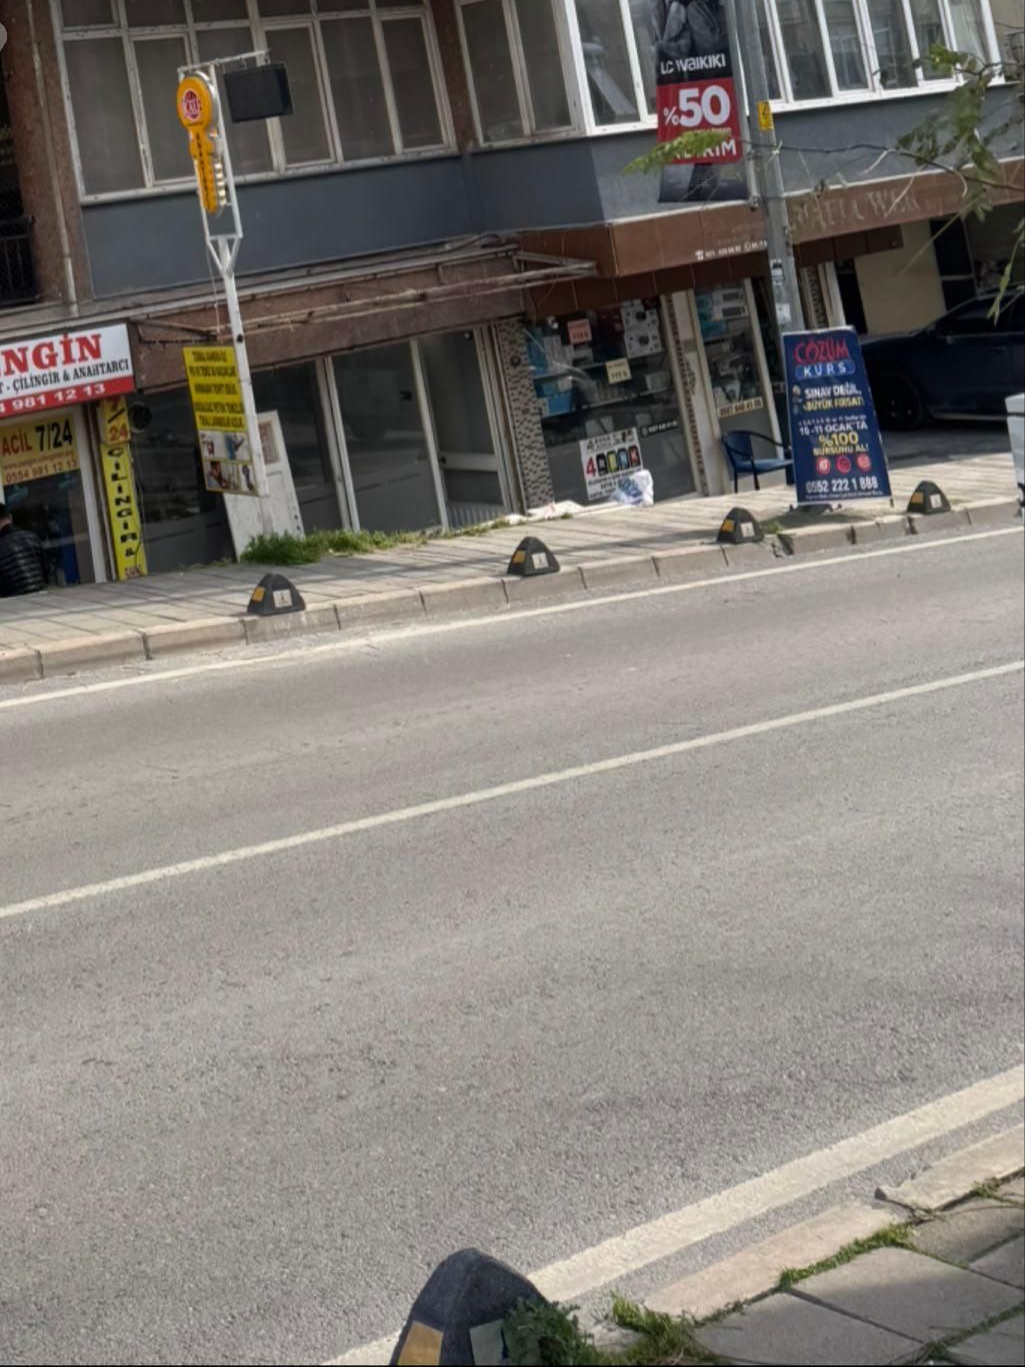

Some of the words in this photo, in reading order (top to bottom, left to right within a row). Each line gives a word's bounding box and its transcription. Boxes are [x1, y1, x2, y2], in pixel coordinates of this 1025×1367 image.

[660, 60, 675, 74] LC
[663, 85, 731, 127] %50
[13, 372, 61, 393] ÇİLİNGİR
[73, 358, 130, 380] ANAHTARCI
[803, 365, 847, 378] KURS
[11, 395, 47, 410] 981
[53, 390, 77, 402] 12
[82, 384, 106, 397] 13
[804, 387, 831, 400] SINAV
[1, 428, 33, 456] ACİL
[35, 418, 73, 452] 7/24
[818, 431, 859, 448] %100
